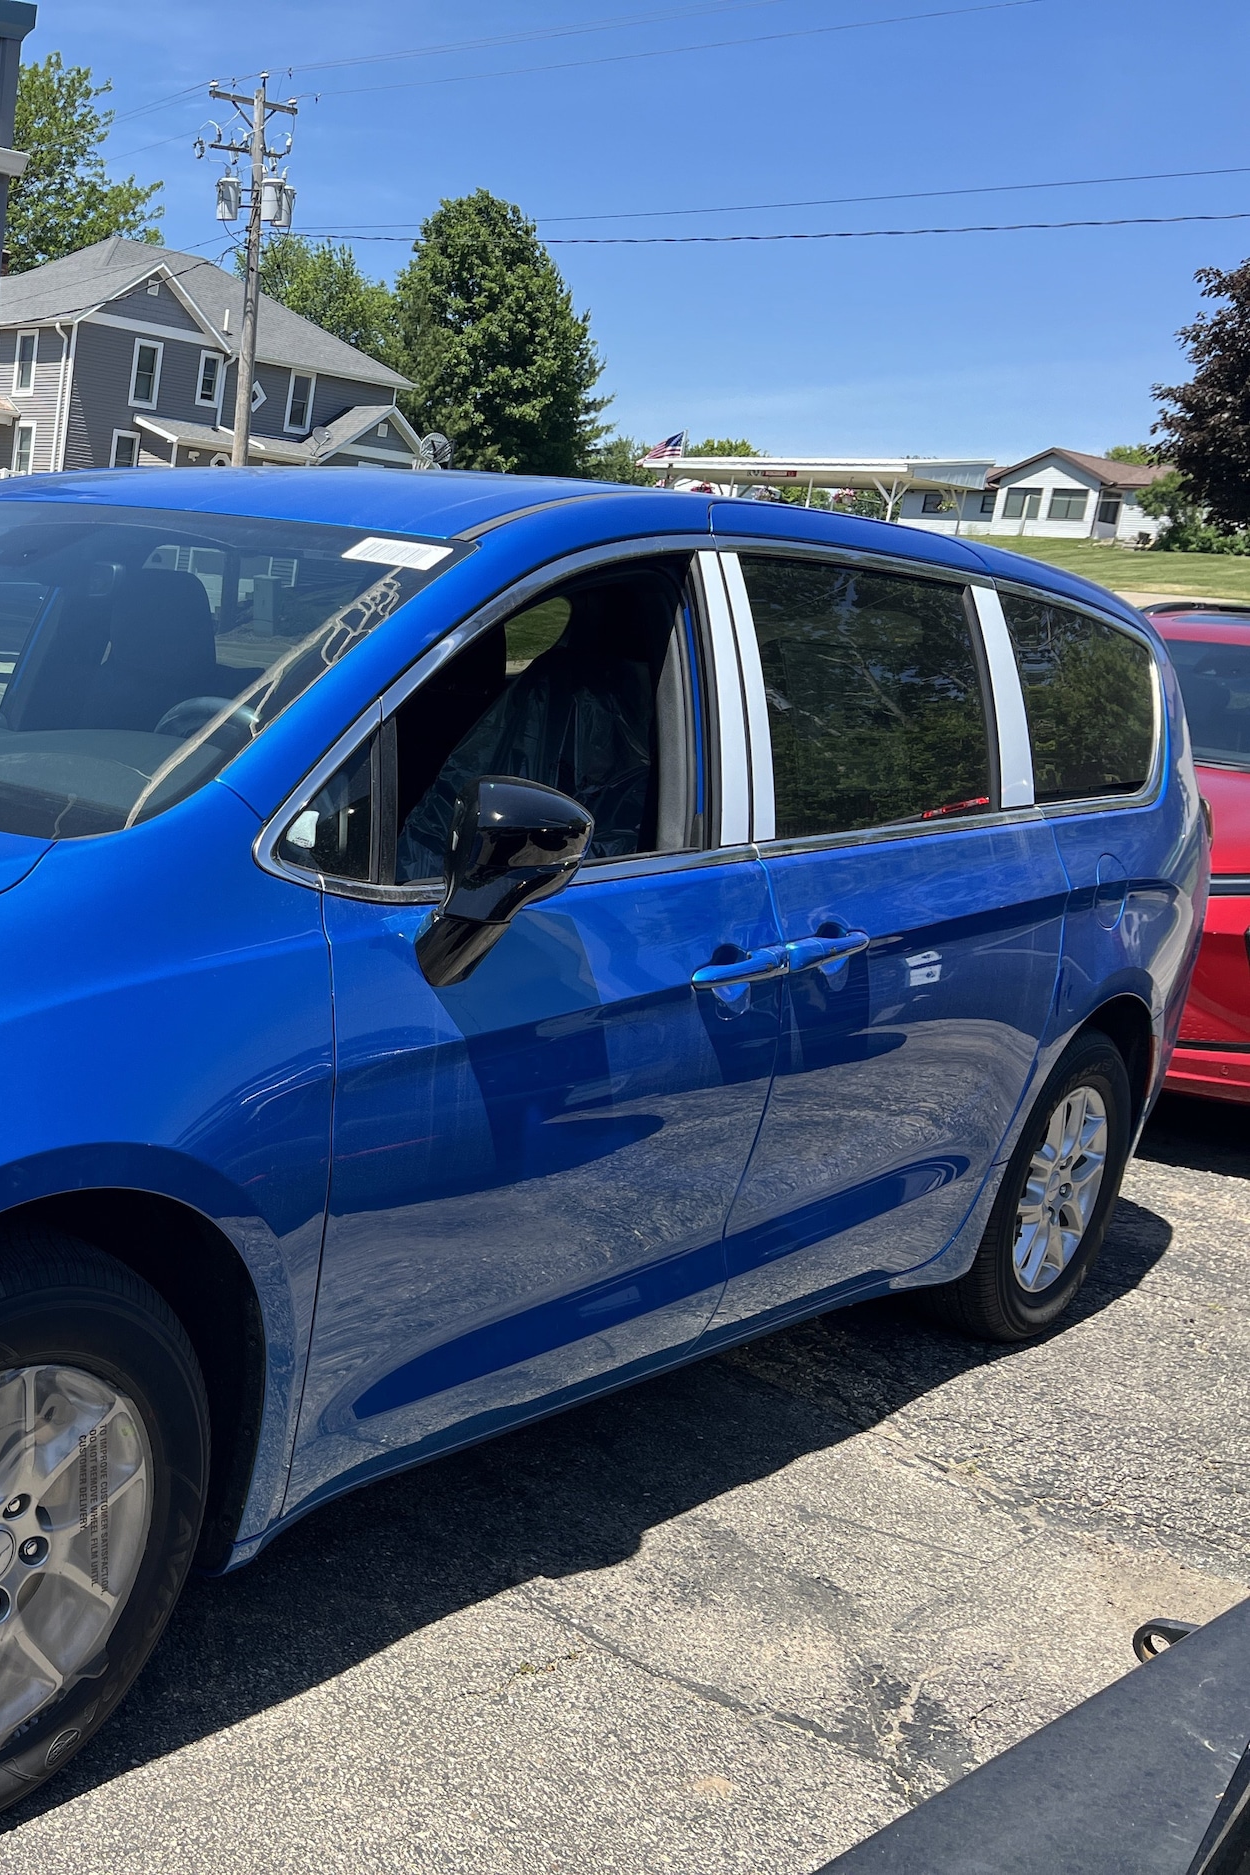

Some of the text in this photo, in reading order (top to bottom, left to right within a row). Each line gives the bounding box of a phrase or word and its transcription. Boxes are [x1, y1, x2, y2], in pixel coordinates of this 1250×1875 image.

[89, 1429, 97, 1442] DO
[100, 1424, 107, 1436] TO
[79, 1435, 87, 1484] CUSTOMER
[100, 1438, 108, 1479] IMPROVE
[90, 1465, 98, 1504] REMOVE
[90, 1504, 98, 1536] WHEEL
[91, 1561, 99, 1587] UNTIL
